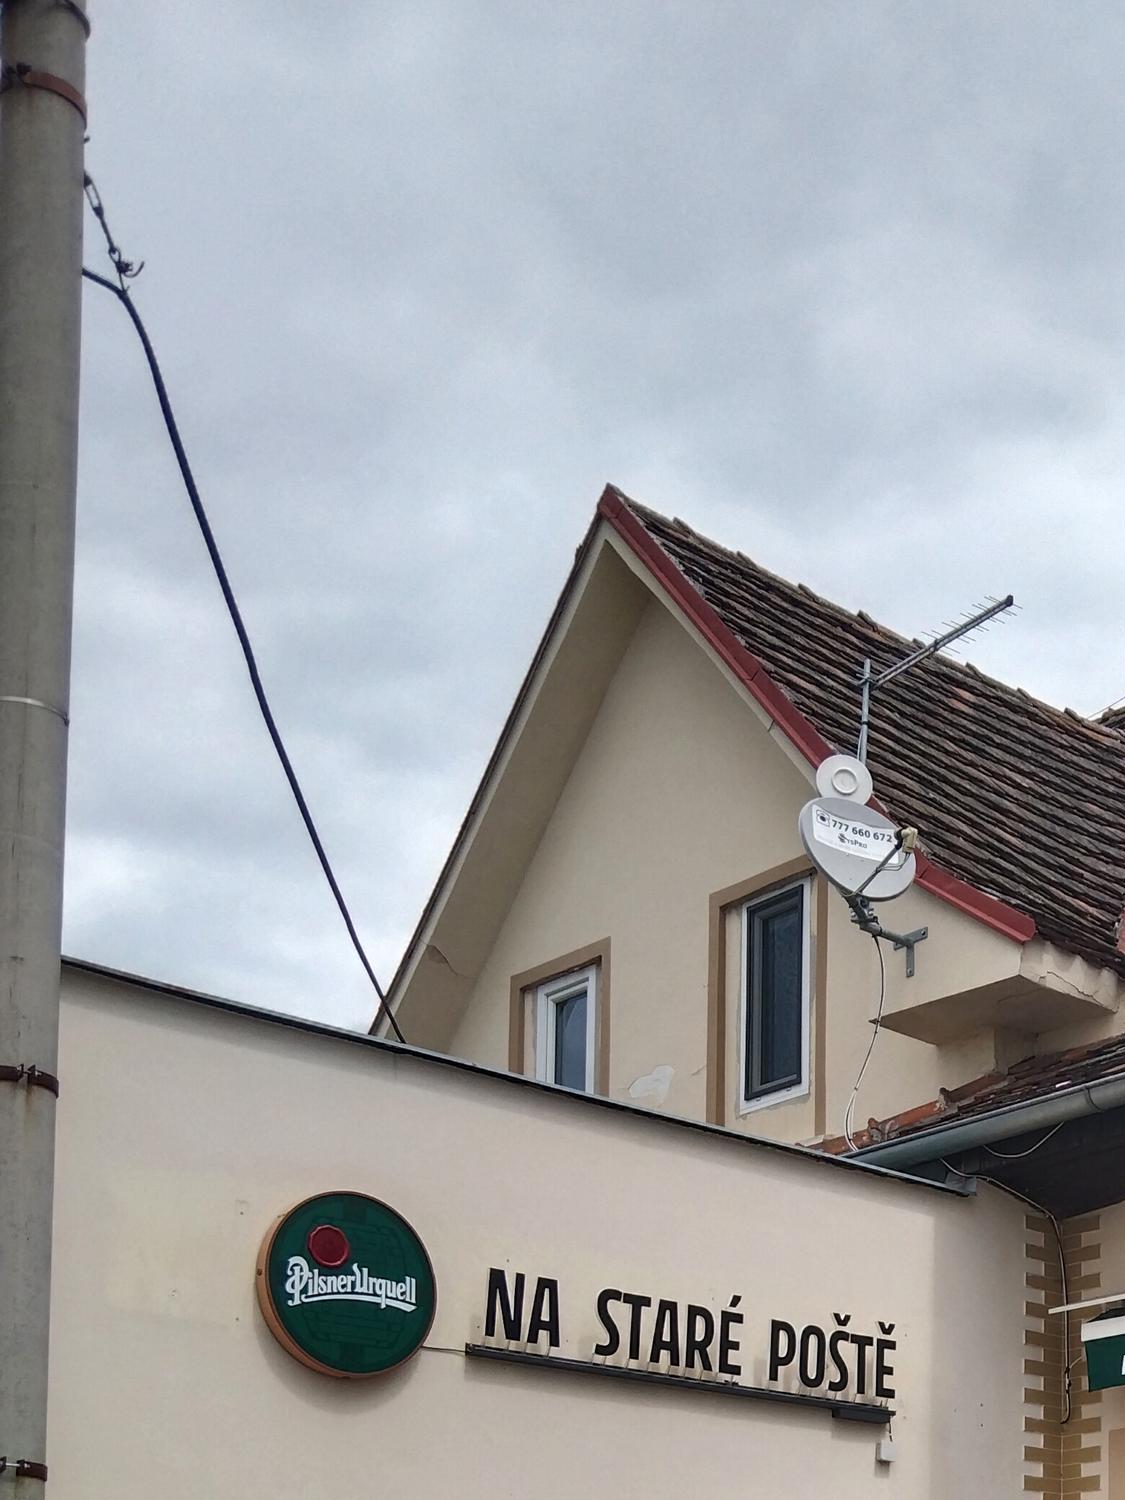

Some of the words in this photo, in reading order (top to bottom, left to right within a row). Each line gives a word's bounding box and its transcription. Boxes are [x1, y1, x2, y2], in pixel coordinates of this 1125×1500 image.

[832, 819, 849, 832] 777
[852, 827, 871, 838] 660
[873, 832, 893, 843] 672
[484, 1266, 561, 1348] NA
[594, 1287, 744, 1376] STARÉ
[768, 1311, 897, 1398] POŠTĚ
